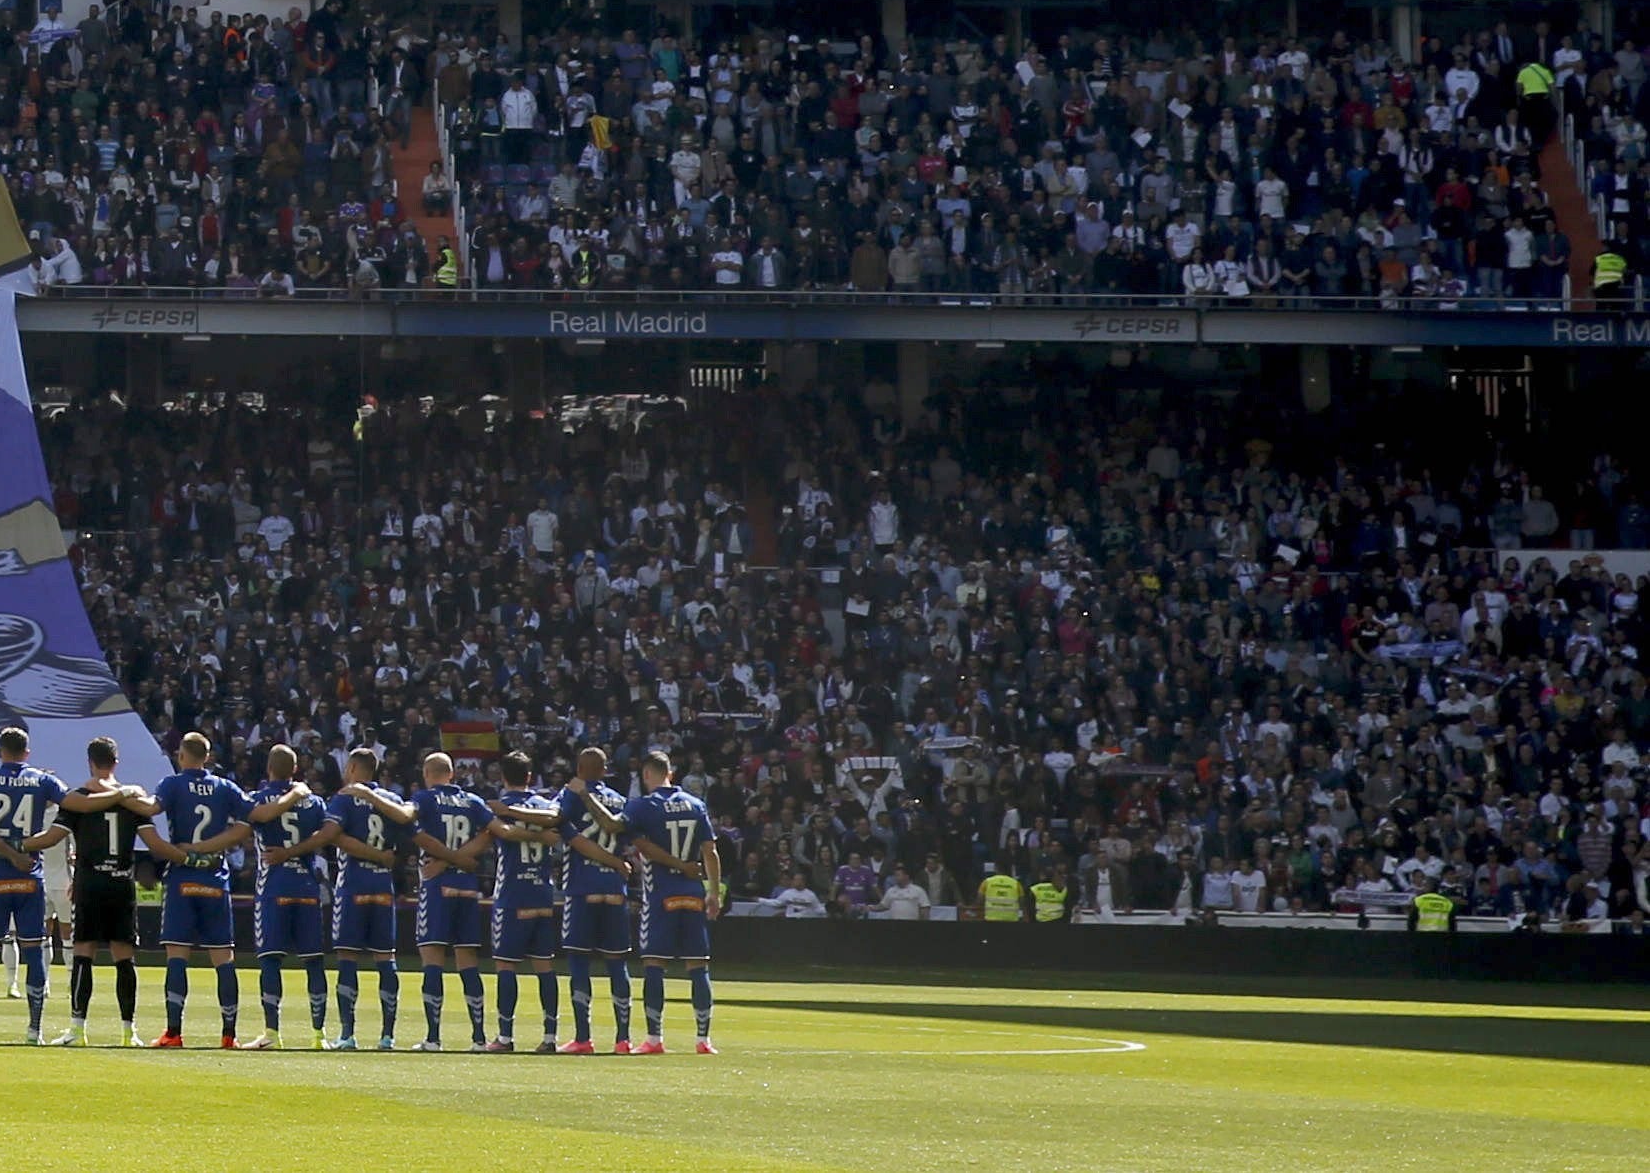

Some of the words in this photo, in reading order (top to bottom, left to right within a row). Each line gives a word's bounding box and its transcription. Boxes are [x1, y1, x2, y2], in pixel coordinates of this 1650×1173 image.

[124, 308, 195, 326] CEPSA
[550, 309, 607, 335] Real
[617, 309, 707, 335] Madrid
[1106, 317, 1180, 334] CEPSA
[1553, 319, 1613, 342] Real
[104, 812, 119, 856] 1
[193, 804, 213, 844] 2
[280, 812, 300, 849] 5
[367, 813, 386, 851] 8
[441, 814, 471, 851] 18
[665, 819, 698, 862] 17
